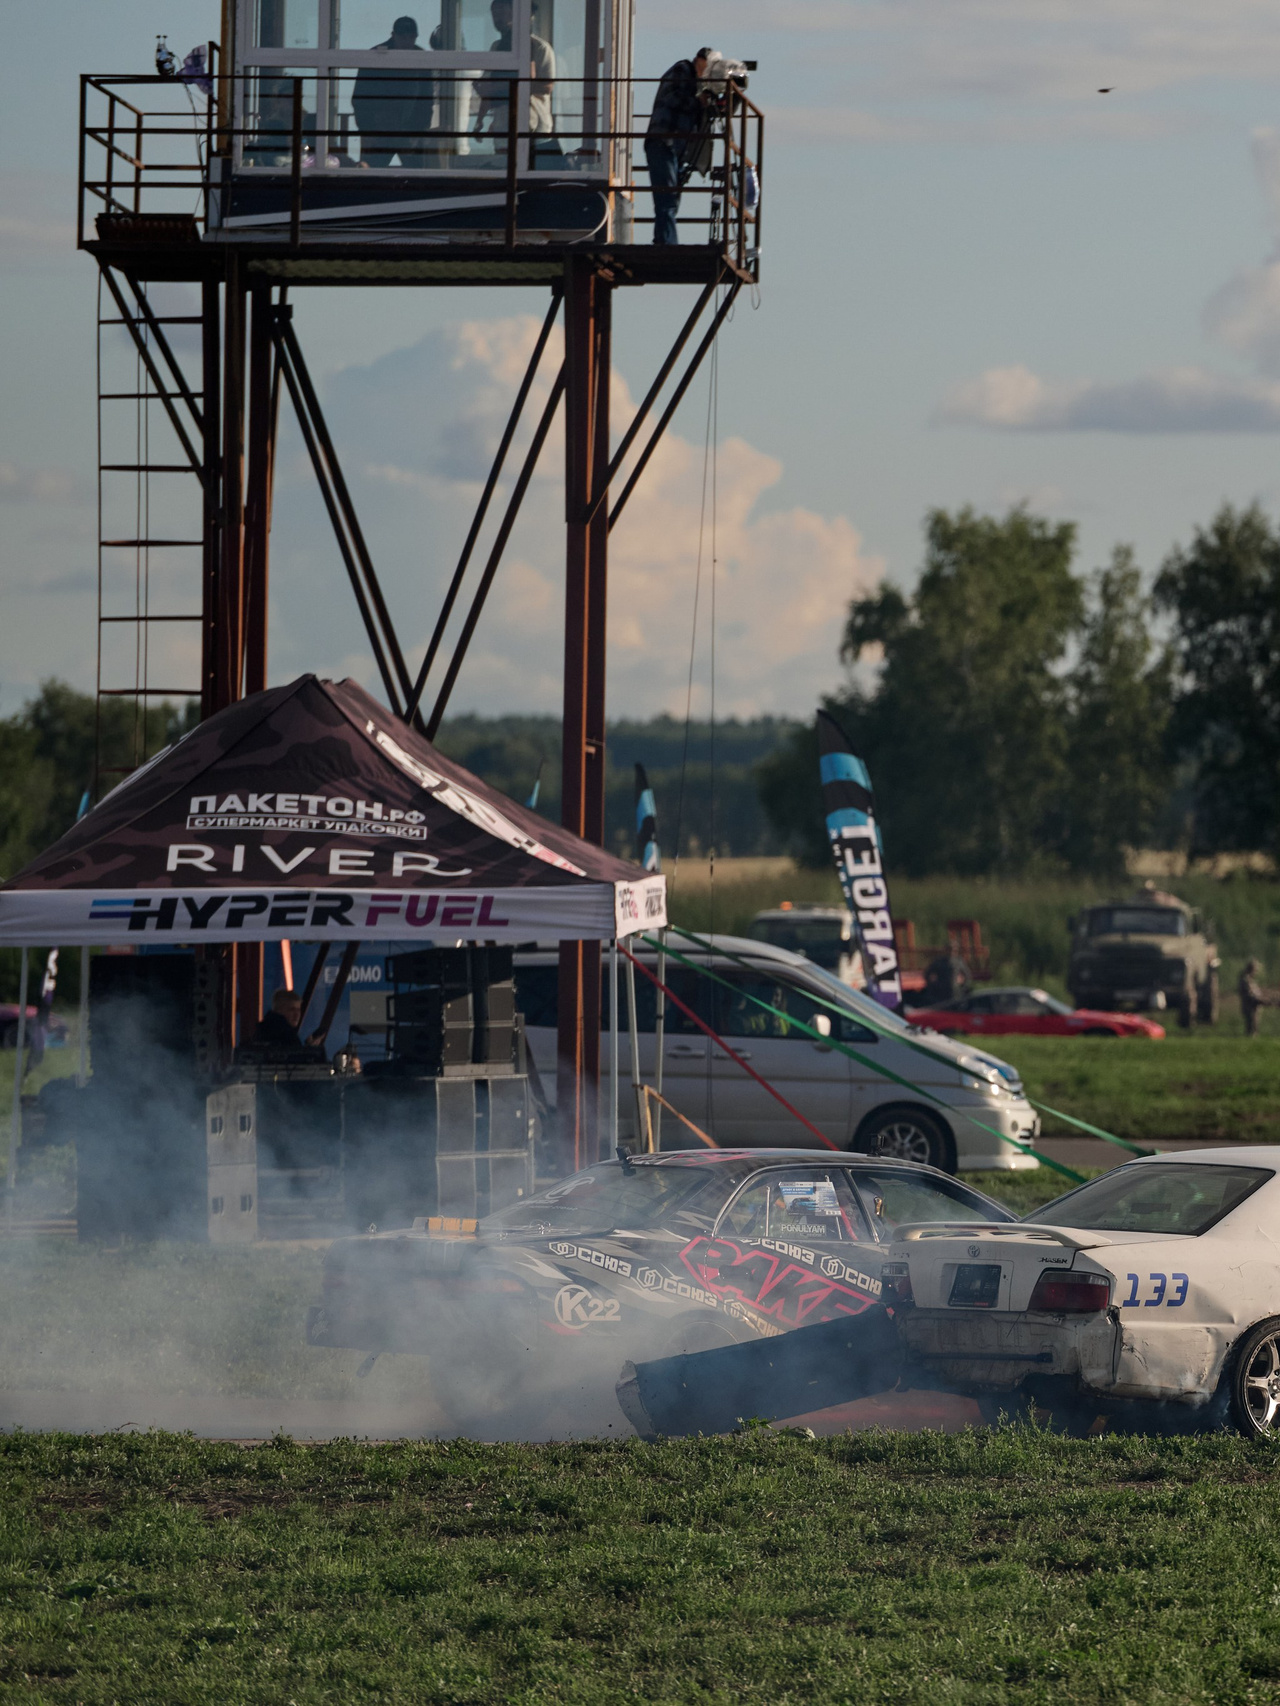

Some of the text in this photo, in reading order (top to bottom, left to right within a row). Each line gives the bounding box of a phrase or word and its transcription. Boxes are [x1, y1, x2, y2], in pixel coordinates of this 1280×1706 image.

[194, 817, 421, 837] СУПЕРМАРКЕТ УПАКОВКИ
[166, 843, 473, 877] RIVER
[128, 893, 510, 930] HYPER FUEL
[577, 1247, 632, 1278] СОЮЗ
[663, 1278, 718, 1308] СОЮЗ
[761, 1238, 882, 1296] СОЮЗ СОЮ
[1122, 1273, 1189, 1307] 133
